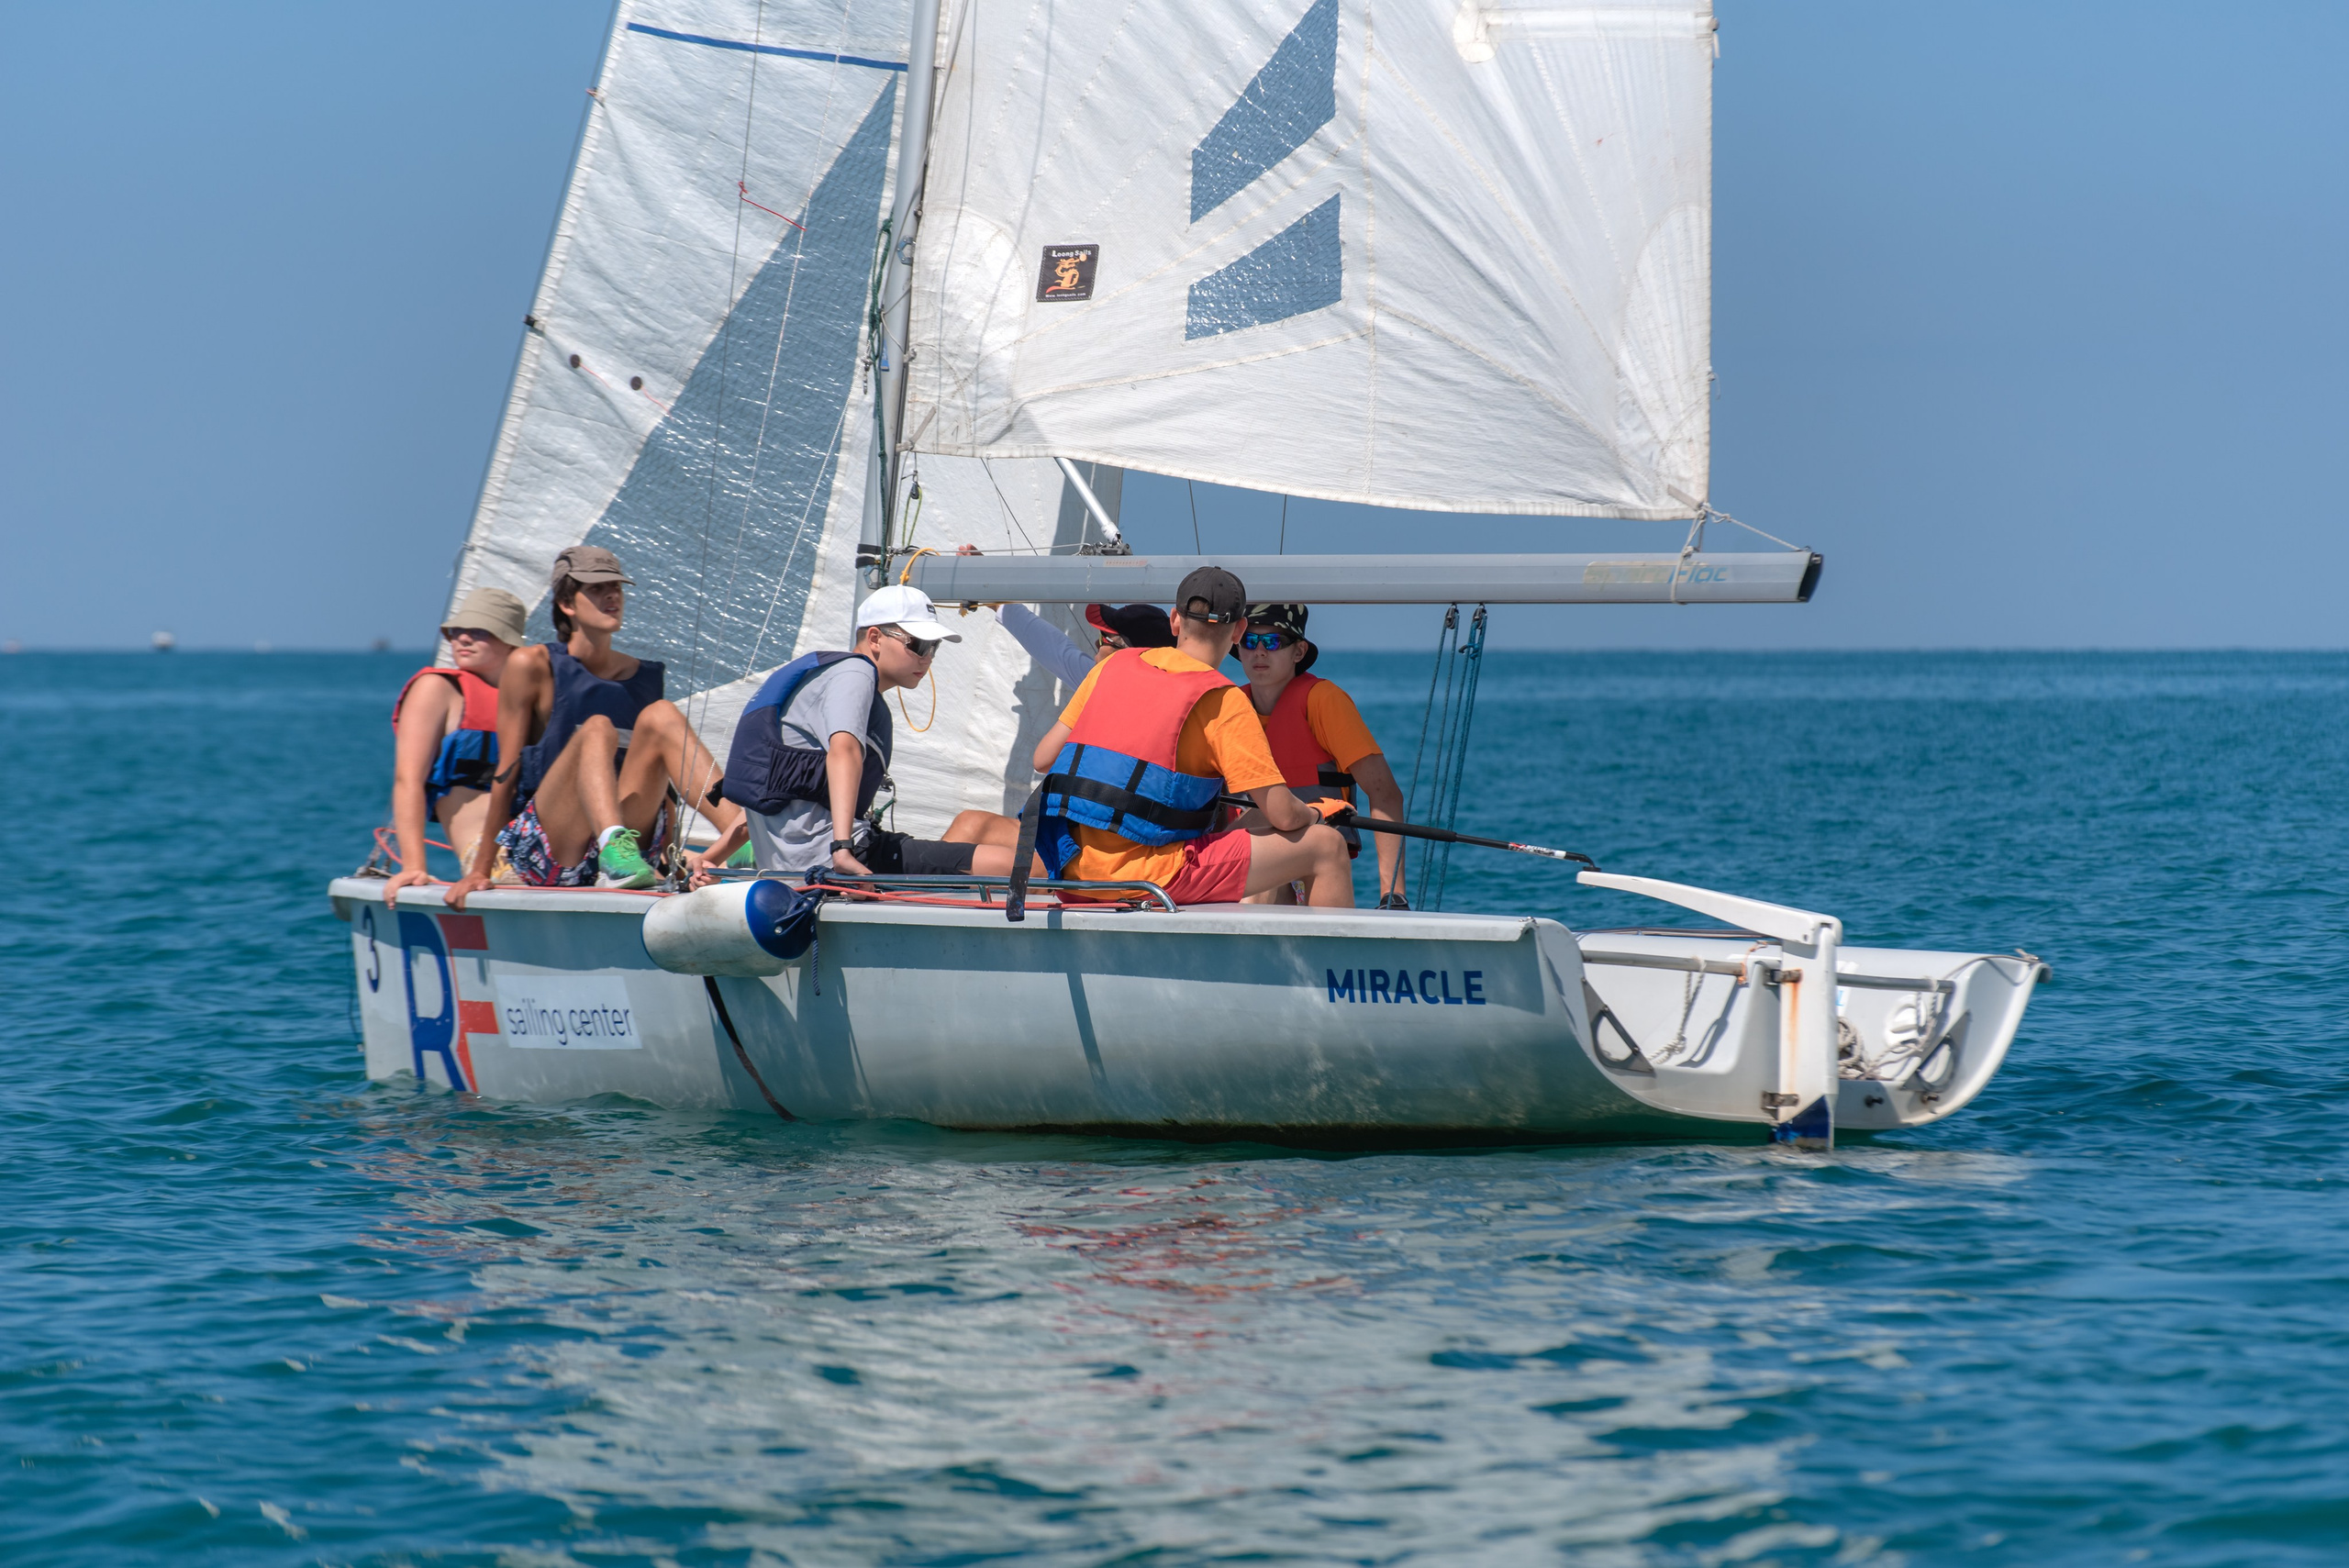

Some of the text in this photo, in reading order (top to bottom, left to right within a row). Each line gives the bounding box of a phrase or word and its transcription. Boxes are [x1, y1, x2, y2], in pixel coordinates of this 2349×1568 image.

[1052, 250, 1074, 258] Loong
[362, 904, 380, 993] 3
[1326, 969, 1486, 1006] MIRACLE
[507, 997, 633, 1046] sailing center
